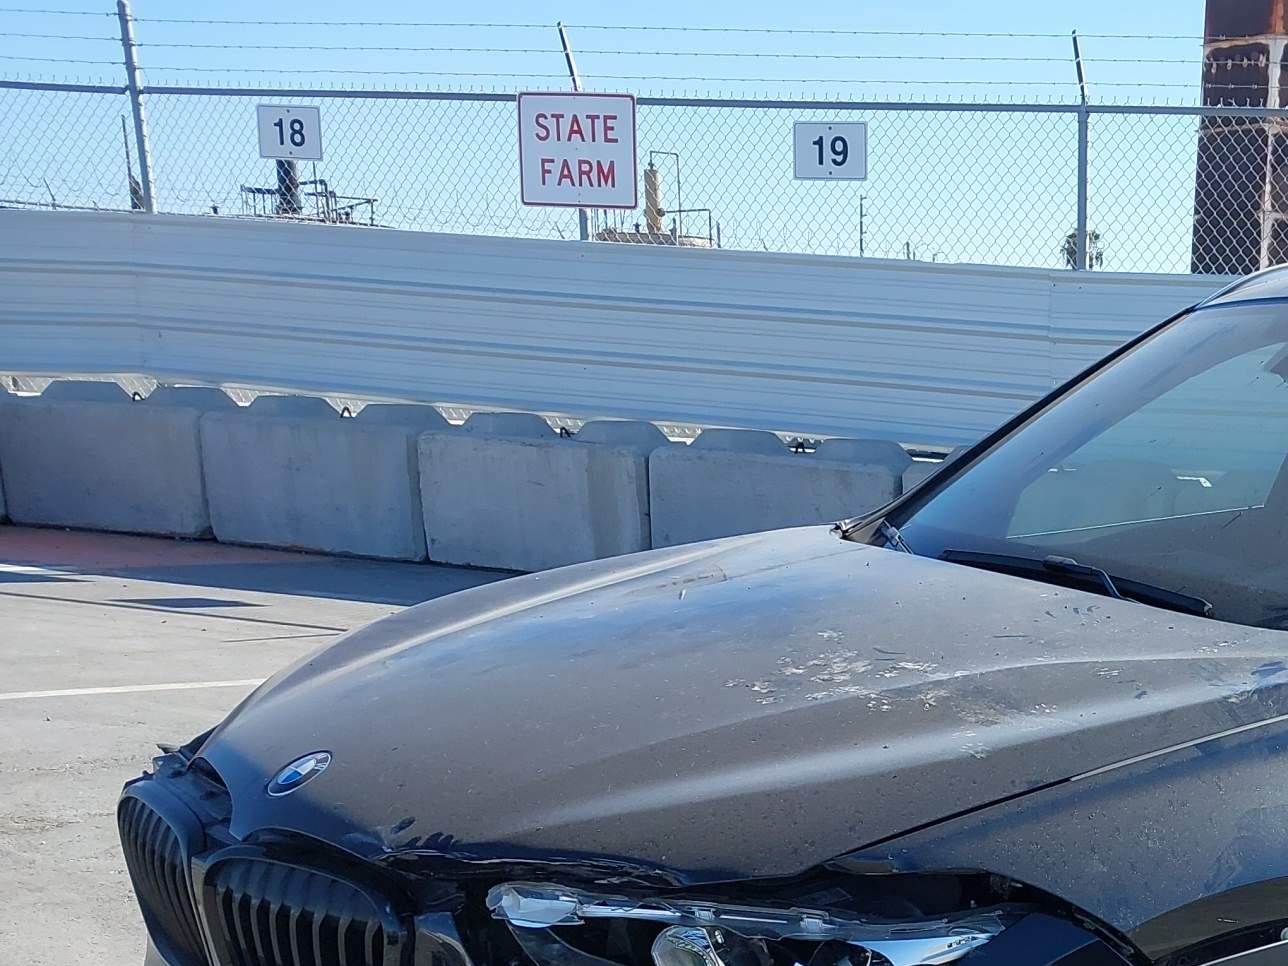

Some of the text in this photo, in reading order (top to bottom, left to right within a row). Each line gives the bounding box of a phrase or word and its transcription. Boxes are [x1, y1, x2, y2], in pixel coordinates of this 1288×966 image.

[273, 118, 306, 147] 18
[534, 112, 619, 145] STATE
[811, 134, 849, 167] 19
[540, 158, 616, 189] FARM
